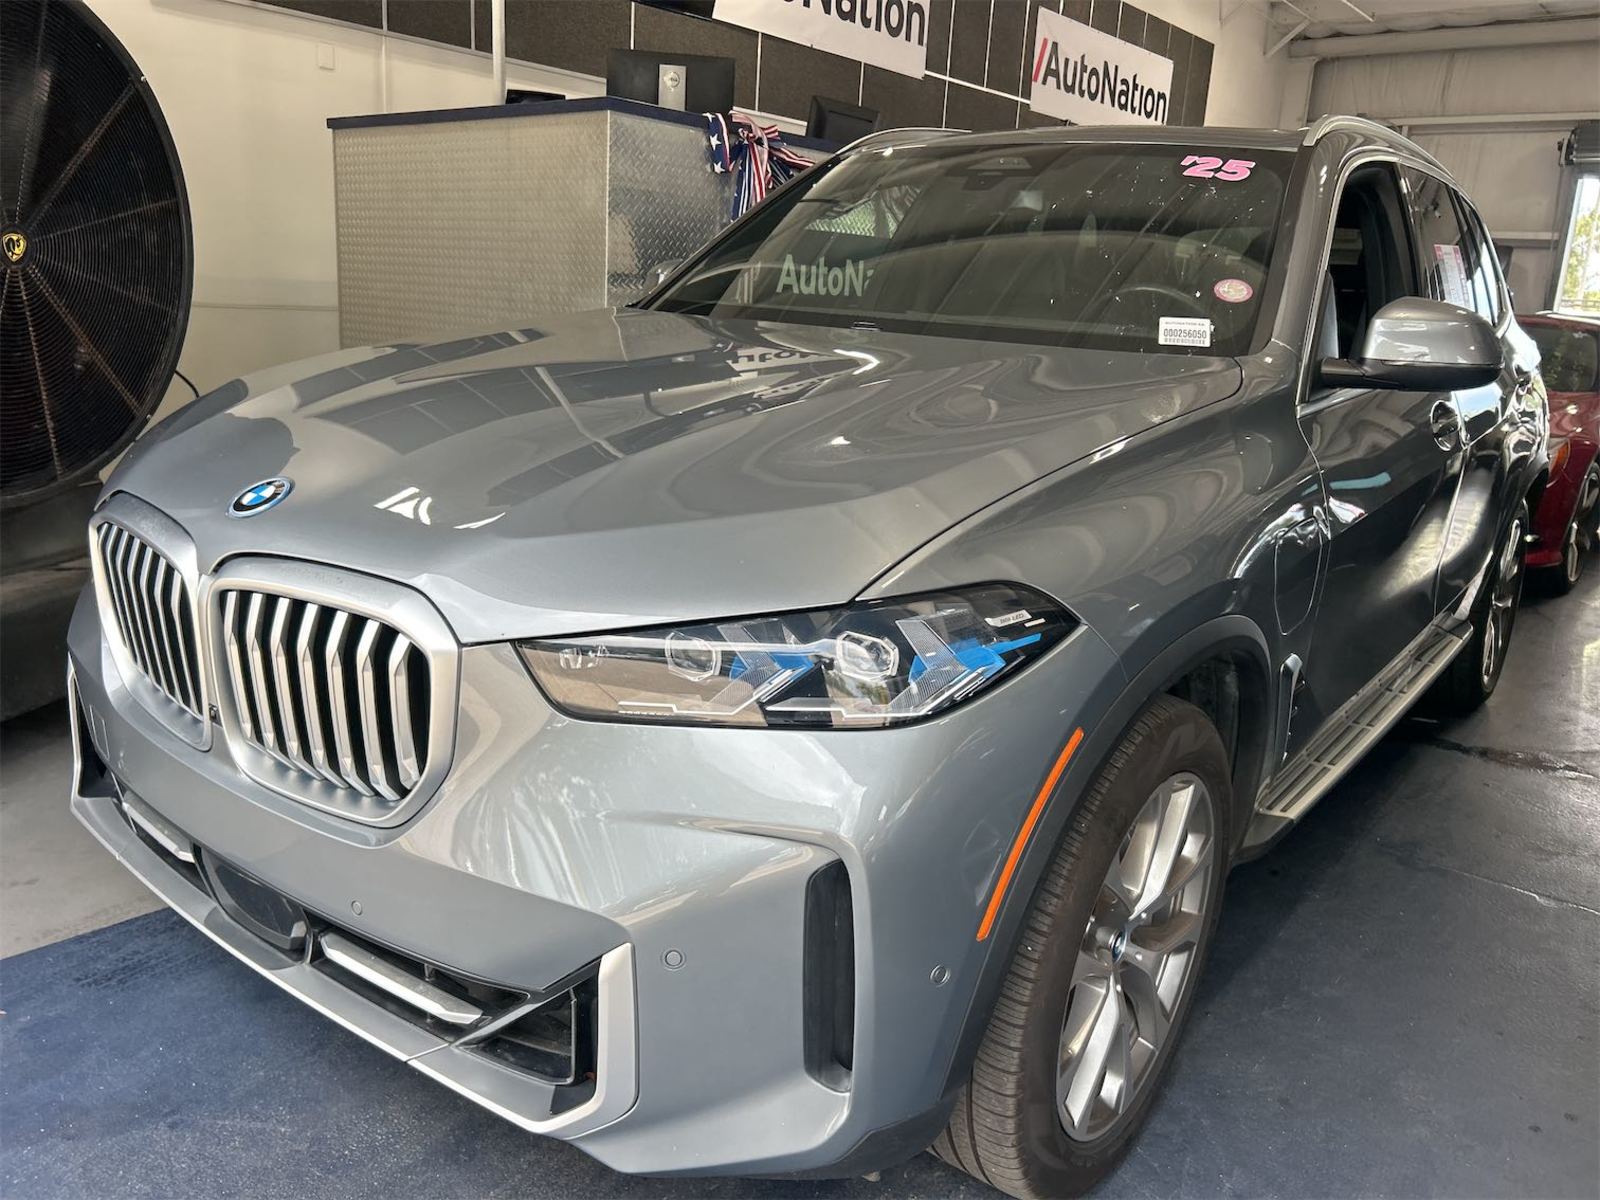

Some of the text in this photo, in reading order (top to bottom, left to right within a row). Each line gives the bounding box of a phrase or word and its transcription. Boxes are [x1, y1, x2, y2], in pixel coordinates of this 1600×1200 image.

[783, 0, 925, 46] ation
[1041, 41, 1167, 124] AutoNation
[776, 254, 874, 297] AutoN
